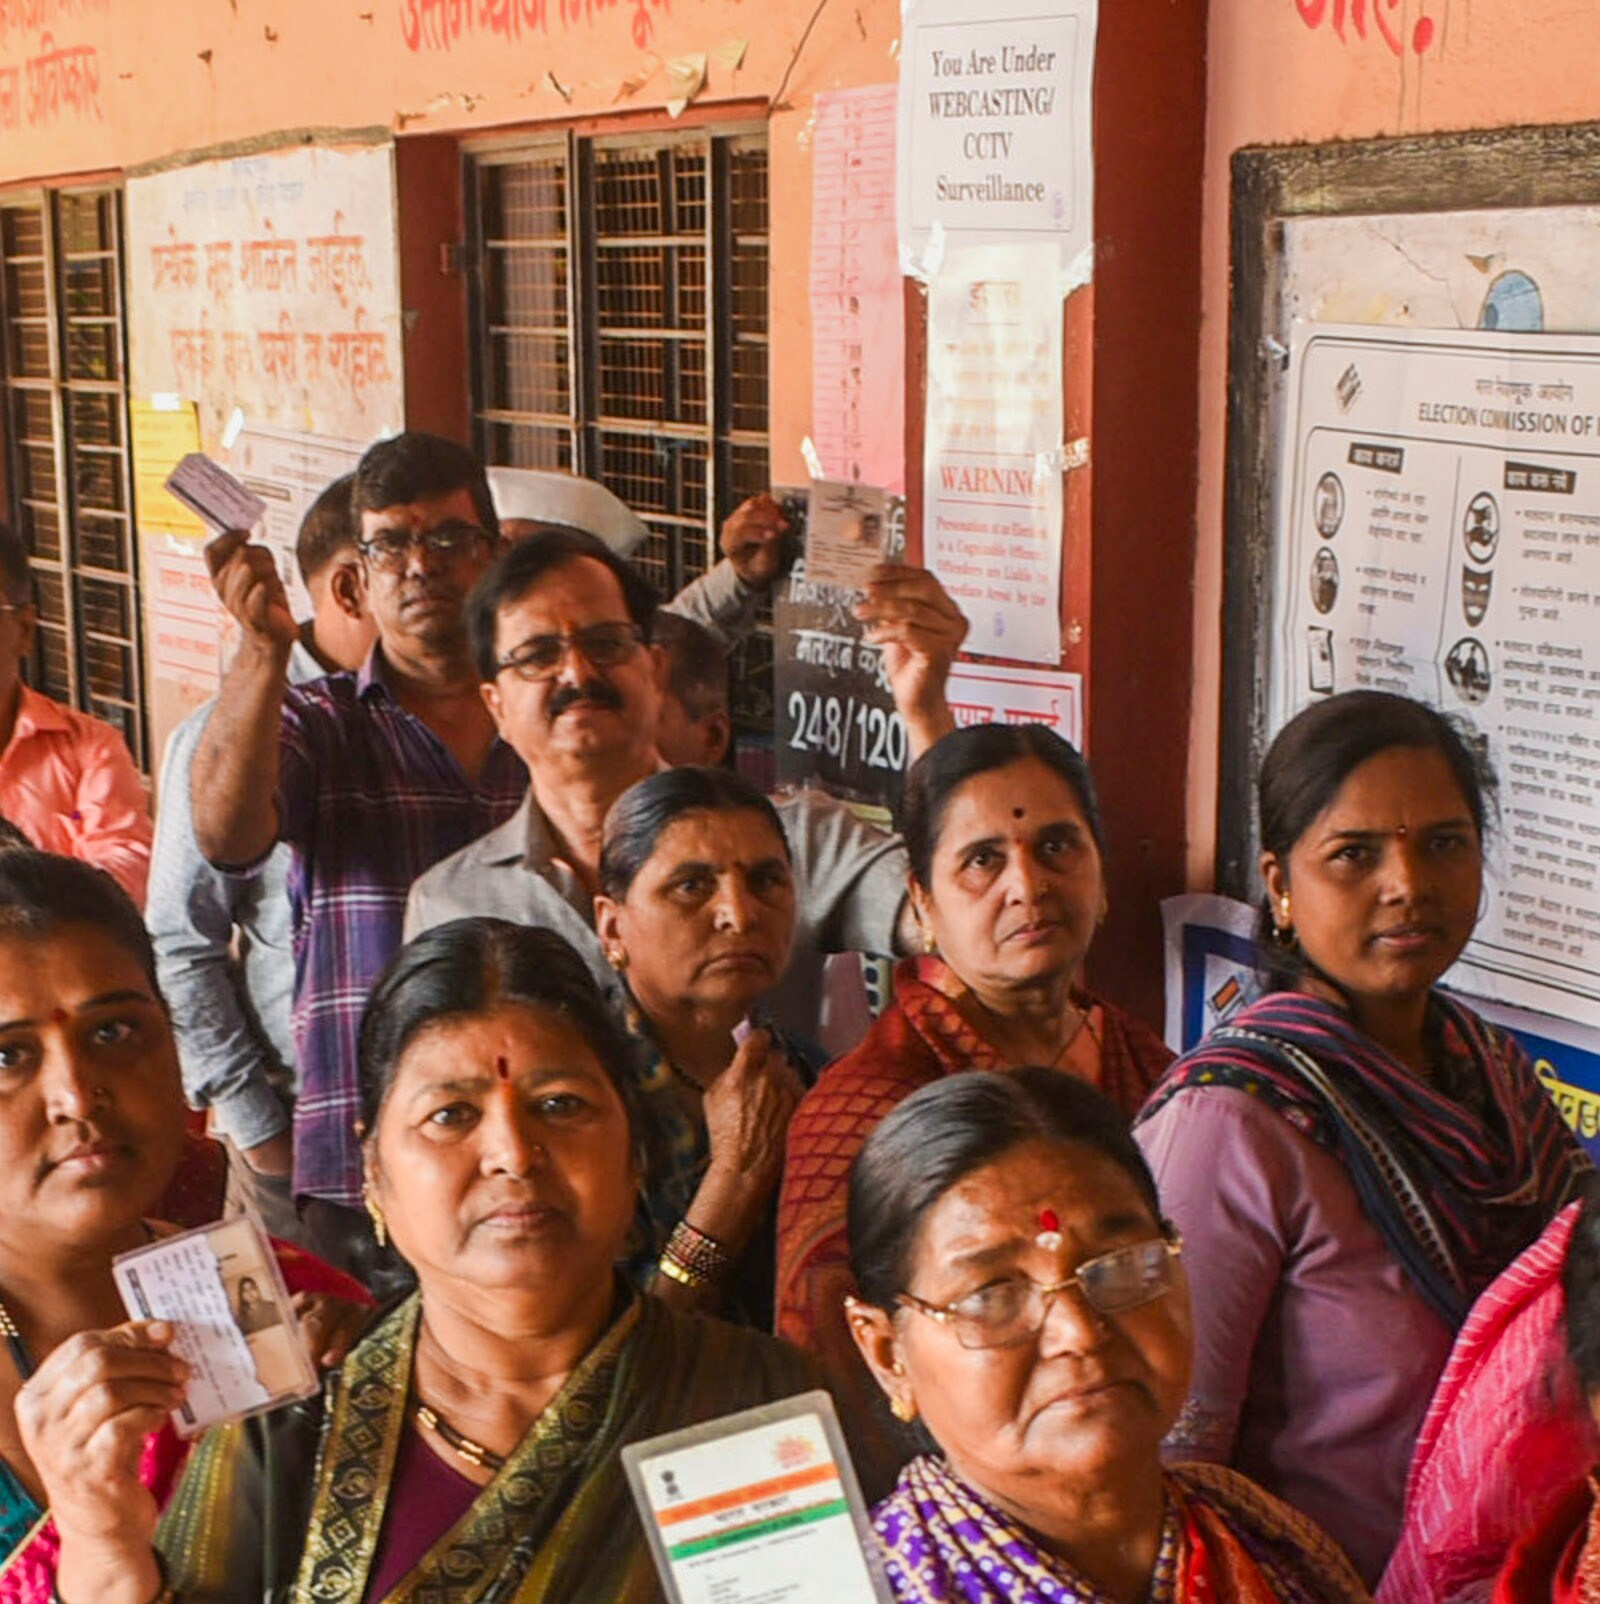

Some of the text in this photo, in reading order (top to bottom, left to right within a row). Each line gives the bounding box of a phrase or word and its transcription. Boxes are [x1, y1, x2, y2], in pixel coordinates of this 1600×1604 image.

[931, 44, 1056, 77] You Are Under
[928, 86, 1056, 119] WEBCASTING/
[963, 131, 1014, 160] CCTV
[936, 173, 1046, 203] Surveillance
[1418, 401, 1477, 428] ELECTION
[1571, 414, 1593, 436] OF
[787, 689, 906, 773] 248/120
